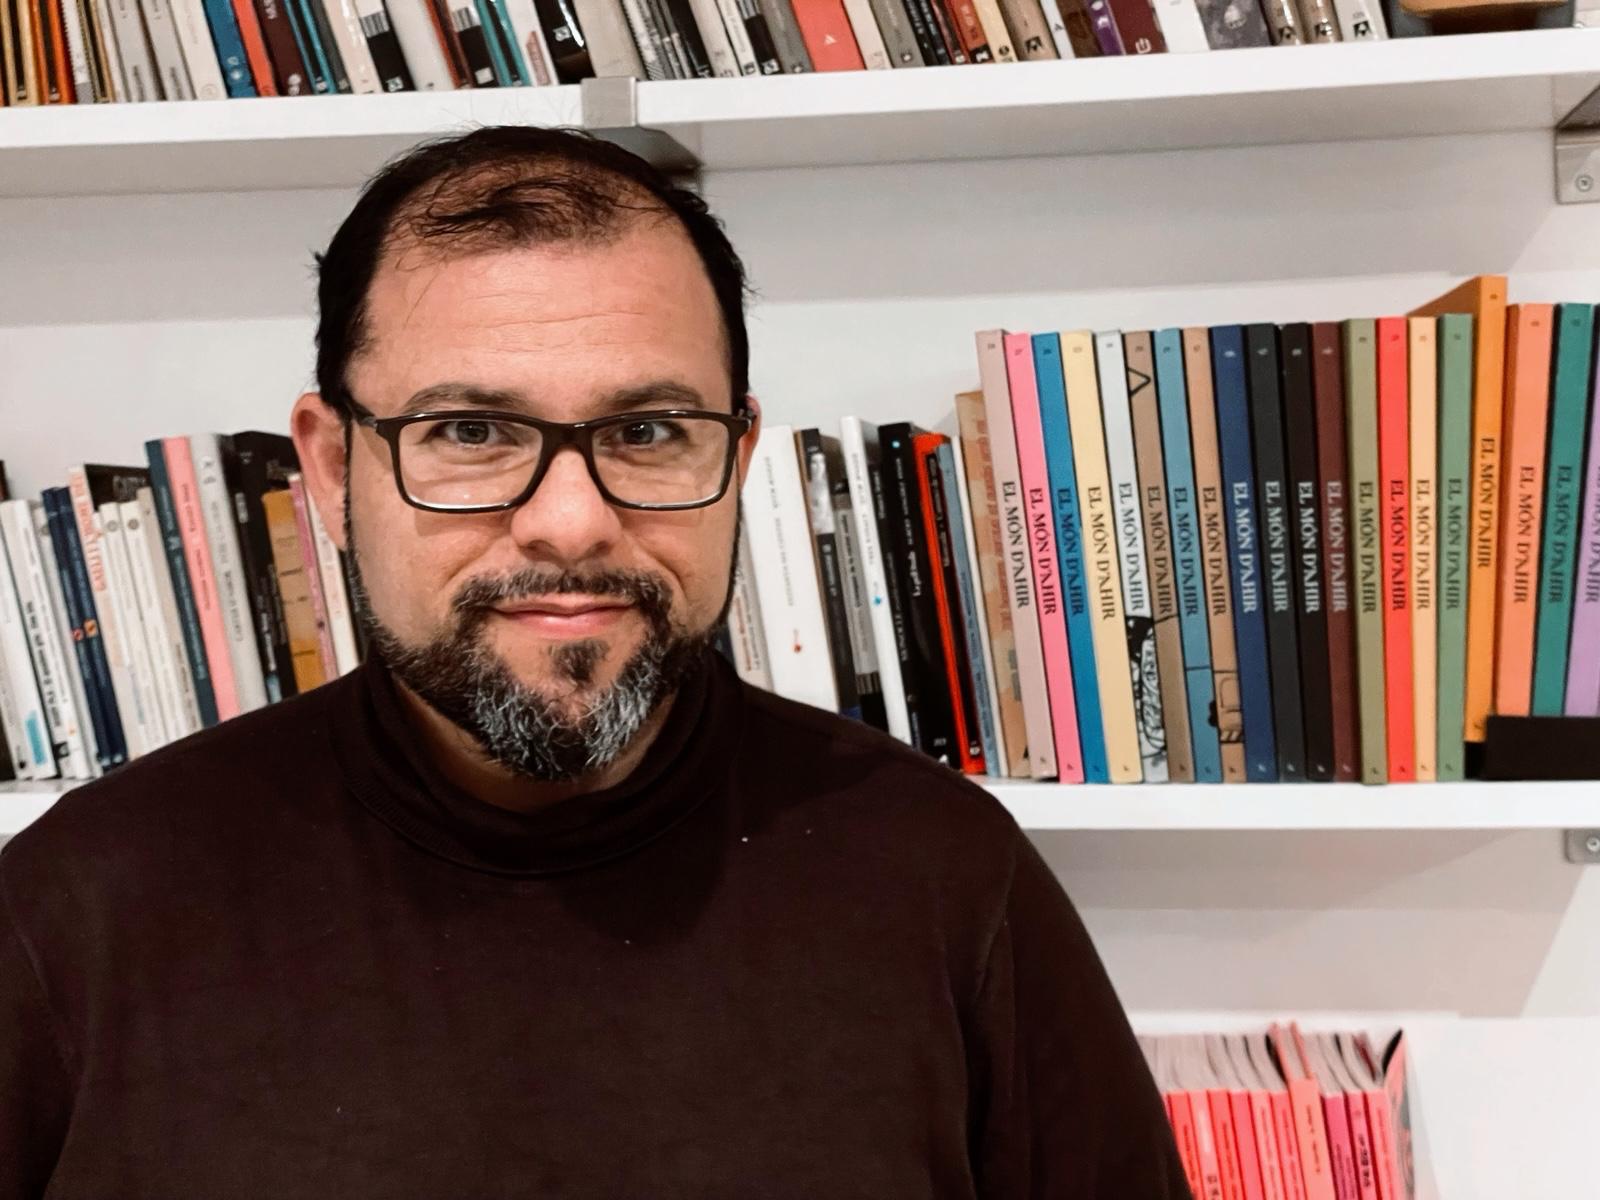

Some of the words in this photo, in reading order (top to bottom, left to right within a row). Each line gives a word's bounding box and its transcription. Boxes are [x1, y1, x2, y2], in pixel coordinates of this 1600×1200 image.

[1481, 438, 1494, 458] EL
[1520, 466, 1534, 488] EL
[1203, 488, 1217, 508] EL
[1233, 483, 1248, 504] EL
[1266, 481, 1280, 503] EL
[1299, 482, 1313, 503] EL
[1327, 481, 1341, 503] EL
[1360, 482, 1374, 503] EL
[1391, 480, 1403, 500] EL
[1417, 479, 1429, 500] EL
[1003, 481, 1016, 502] EL
[1012, 552, 1029, 609] D'AHIR
[1030, 488, 1044, 509] EL
[1038, 559, 1057, 616] D'AHIR
[1088, 487, 1102, 508] EL
[1097, 560, 1115, 620] D'AHIR
[1119, 483, 1133, 504] EL
[1126, 554, 1144, 611] D'AHIR
[1147, 486, 1161, 506] EL
[1154, 557, 1172, 615] D'AHIR
[1174, 488, 1188, 509] EL
[1181, 559, 1198, 617] D'AHIR
[1478, 510, 1492, 568] D'AHIR
[1209, 559, 1226, 616] D'AHIR
[1238, 554, 1257, 613] D'AHIR
[1271, 554, 1288, 613] D'AHIR
[1301, 554, 1319, 613] D'AHIR
[1330, 553, 1347, 613] D'AHIR
[1362, 555, 1376, 613] D'AHIR
[1391, 553, 1405, 611] D'AHIR
[1417, 551, 1430, 610] D'AHIR
[1514, 542, 1530, 604] D'AHIR
